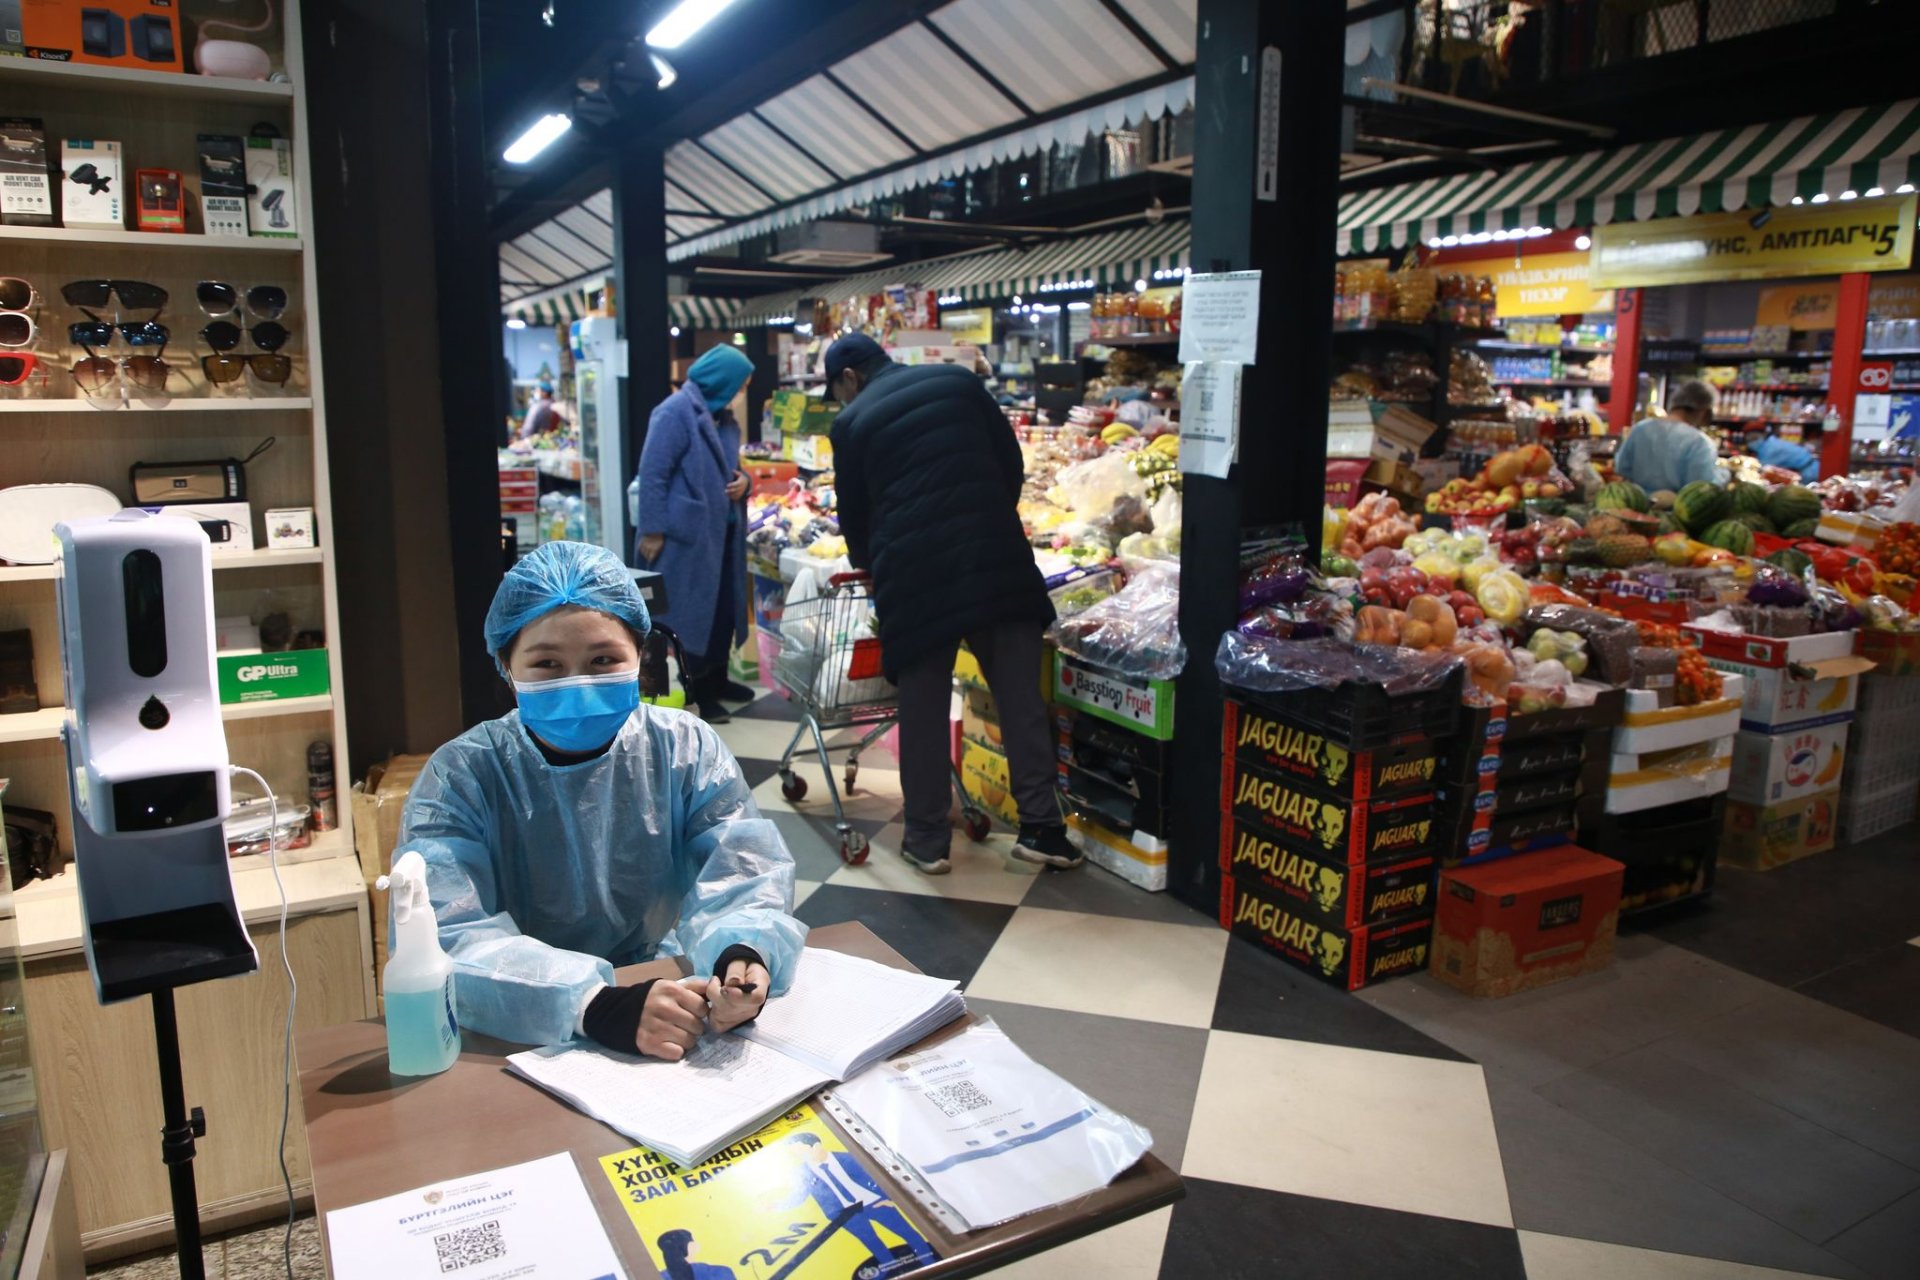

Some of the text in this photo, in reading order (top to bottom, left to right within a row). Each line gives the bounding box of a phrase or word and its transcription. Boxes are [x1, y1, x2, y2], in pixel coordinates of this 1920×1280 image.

[1760, 223, 1878, 251] АМТЛАГЧ
[1874, 225, 1900, 256] 5
[237, 665, 266, 682] GP
[267, 665, 298, 676] Ultra
[1077, 672, 1152, 715] Basstion Fruit
[1238, 714, 1323, 768] JAGUAR
[1378, 759, 1423, 787] JAGUAR
[1235, 773, 1320, 830] JAGUAR
[1373, 823, 1418, 851] JAGUAR
[1234, 832, 1318, 893] JAGUAR
[1370, 885, 1415, 915] JAGUAR
[1235, 893, 1319, 956] JAGUAR
[1371, 946, 1415, 977] JAGUAR
[612, 1151, 661, 1174] ХҮН
[490, 1189, 514, 1201] ЦЭГ
[630, 1164, 733, 1203] ЗАЙ БАР
